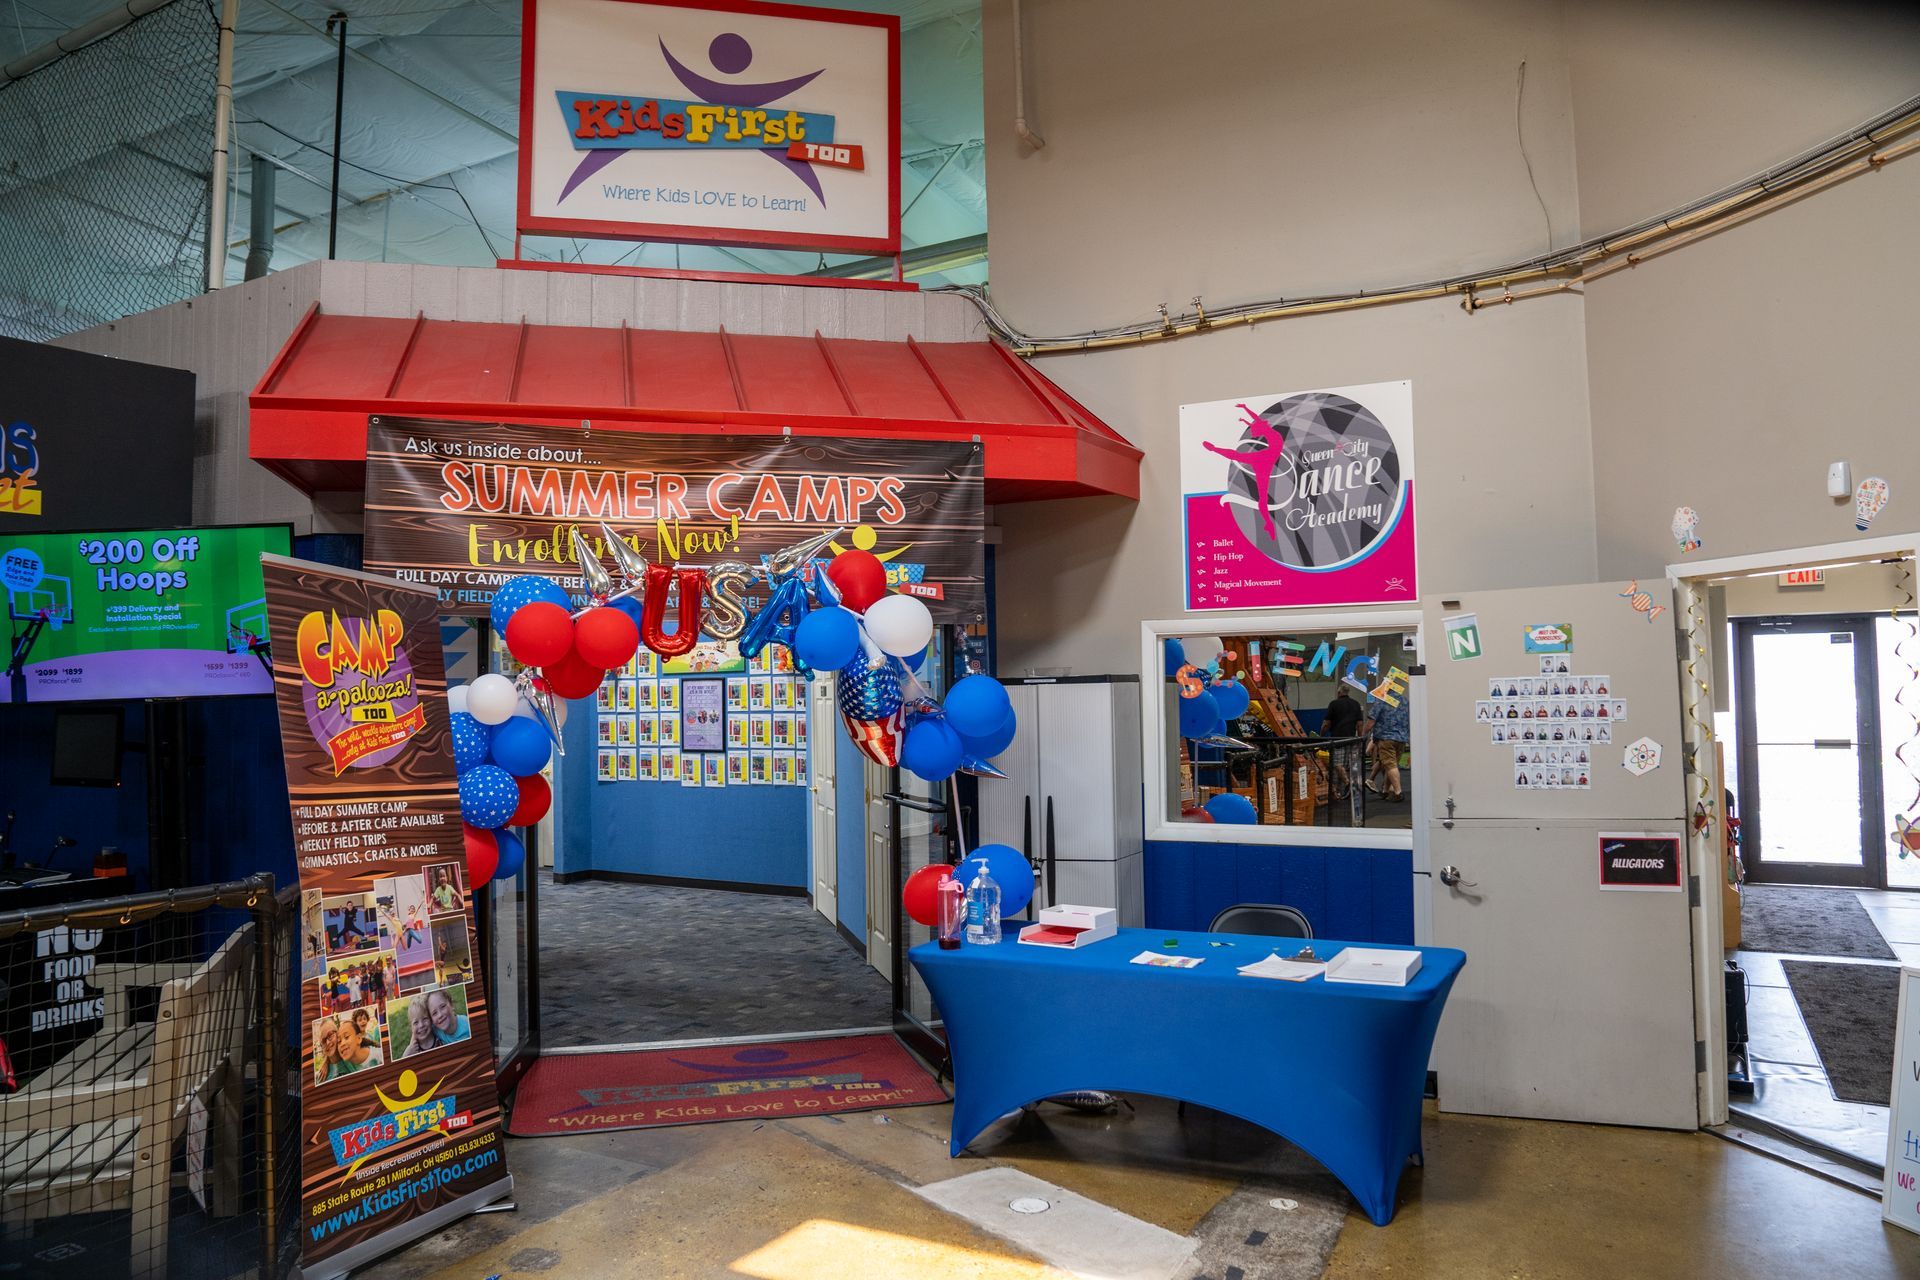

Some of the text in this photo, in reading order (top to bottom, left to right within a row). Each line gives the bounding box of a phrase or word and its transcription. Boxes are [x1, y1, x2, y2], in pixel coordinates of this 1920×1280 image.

[805, 143, 850, 164] TOO
[603, 184, 806, 212] Where Kids LOVE to Learn!
[404, 436, 439, 454] Ask
[443, 442, 463, 456] us
[467, 441, 522, 460] inside
[1302, 439, 1369, 467] Queen City
[440, 461, 906, 525] SUMMER CAMPS
[1286, 493, 1382, 532] Academy
[656, 515, 740, 564] Now!
[1213, 539, 1234, 547] Ballet
[79, 536, 199, 565] $200 Off
[1213, 552, 1244, 563] Hip Hop
[6, 555, 39, 571] FREE
[1213, 567, 1229, 575] Jazz
[96, 567, 188, 596] Hoops
[396, 569, 427, 583] FULL
[430, 571, 461, 584] DAY
[620, 579, 630, 590] &
[1214, 579, 1282, 590] Magical Movement
[457, 589, 495, 603] FIELD
[702, 596, 711, 608] &
[909, 584, 937, 597] TOO
[1213, 594, 1229, 605] Tap
[106, 612, 182, 623] Installation Special
[128, 604, 163, 613] Delivery
[164, 603, 180, 611] and
[297, 608, 404, 688] CAMP
[362, 707, 388, 720] TOO
[300, 801, 408, 819] FULL DAY SUMMER CAMP
[301, 813, 445, 835] BEFORE & AFTER CARE AVAILABLE
[302, 833, 387, 852] WEEKLY FIELD TRIPS
[304, 843, 438, 869] GYMNASTICS, CRAFTS & MORE!
[1611, 857, 1665, 870] ALLIGATORS
[44, 954, 96, 983] FOOD
[56, 979, 85, 1003] OR
[32, 997, 105, 1032] DRINKS
[655, 1106, 717, 1121] Kids
[726, 1100, 785, 1114] Love
[796, 1095, 821, 1108] to
[447, 1115, 468, 1128] TOO
[381, 1148, 421, 1171] Recreations
[312, 1200, 327, 1217] 885
[327, 1193, 349, 1210] State
[350, 1182, 375, 1199] Route
[376, 1176, 387, 1189] 28
[391, 1162, 422, 1183] Milford,
[422, 1156, 435, 1169] OH
[1897, 1171, 1916, 1192] We
[310, 1148, 498, 1242] www.KidsFirstToo.com
